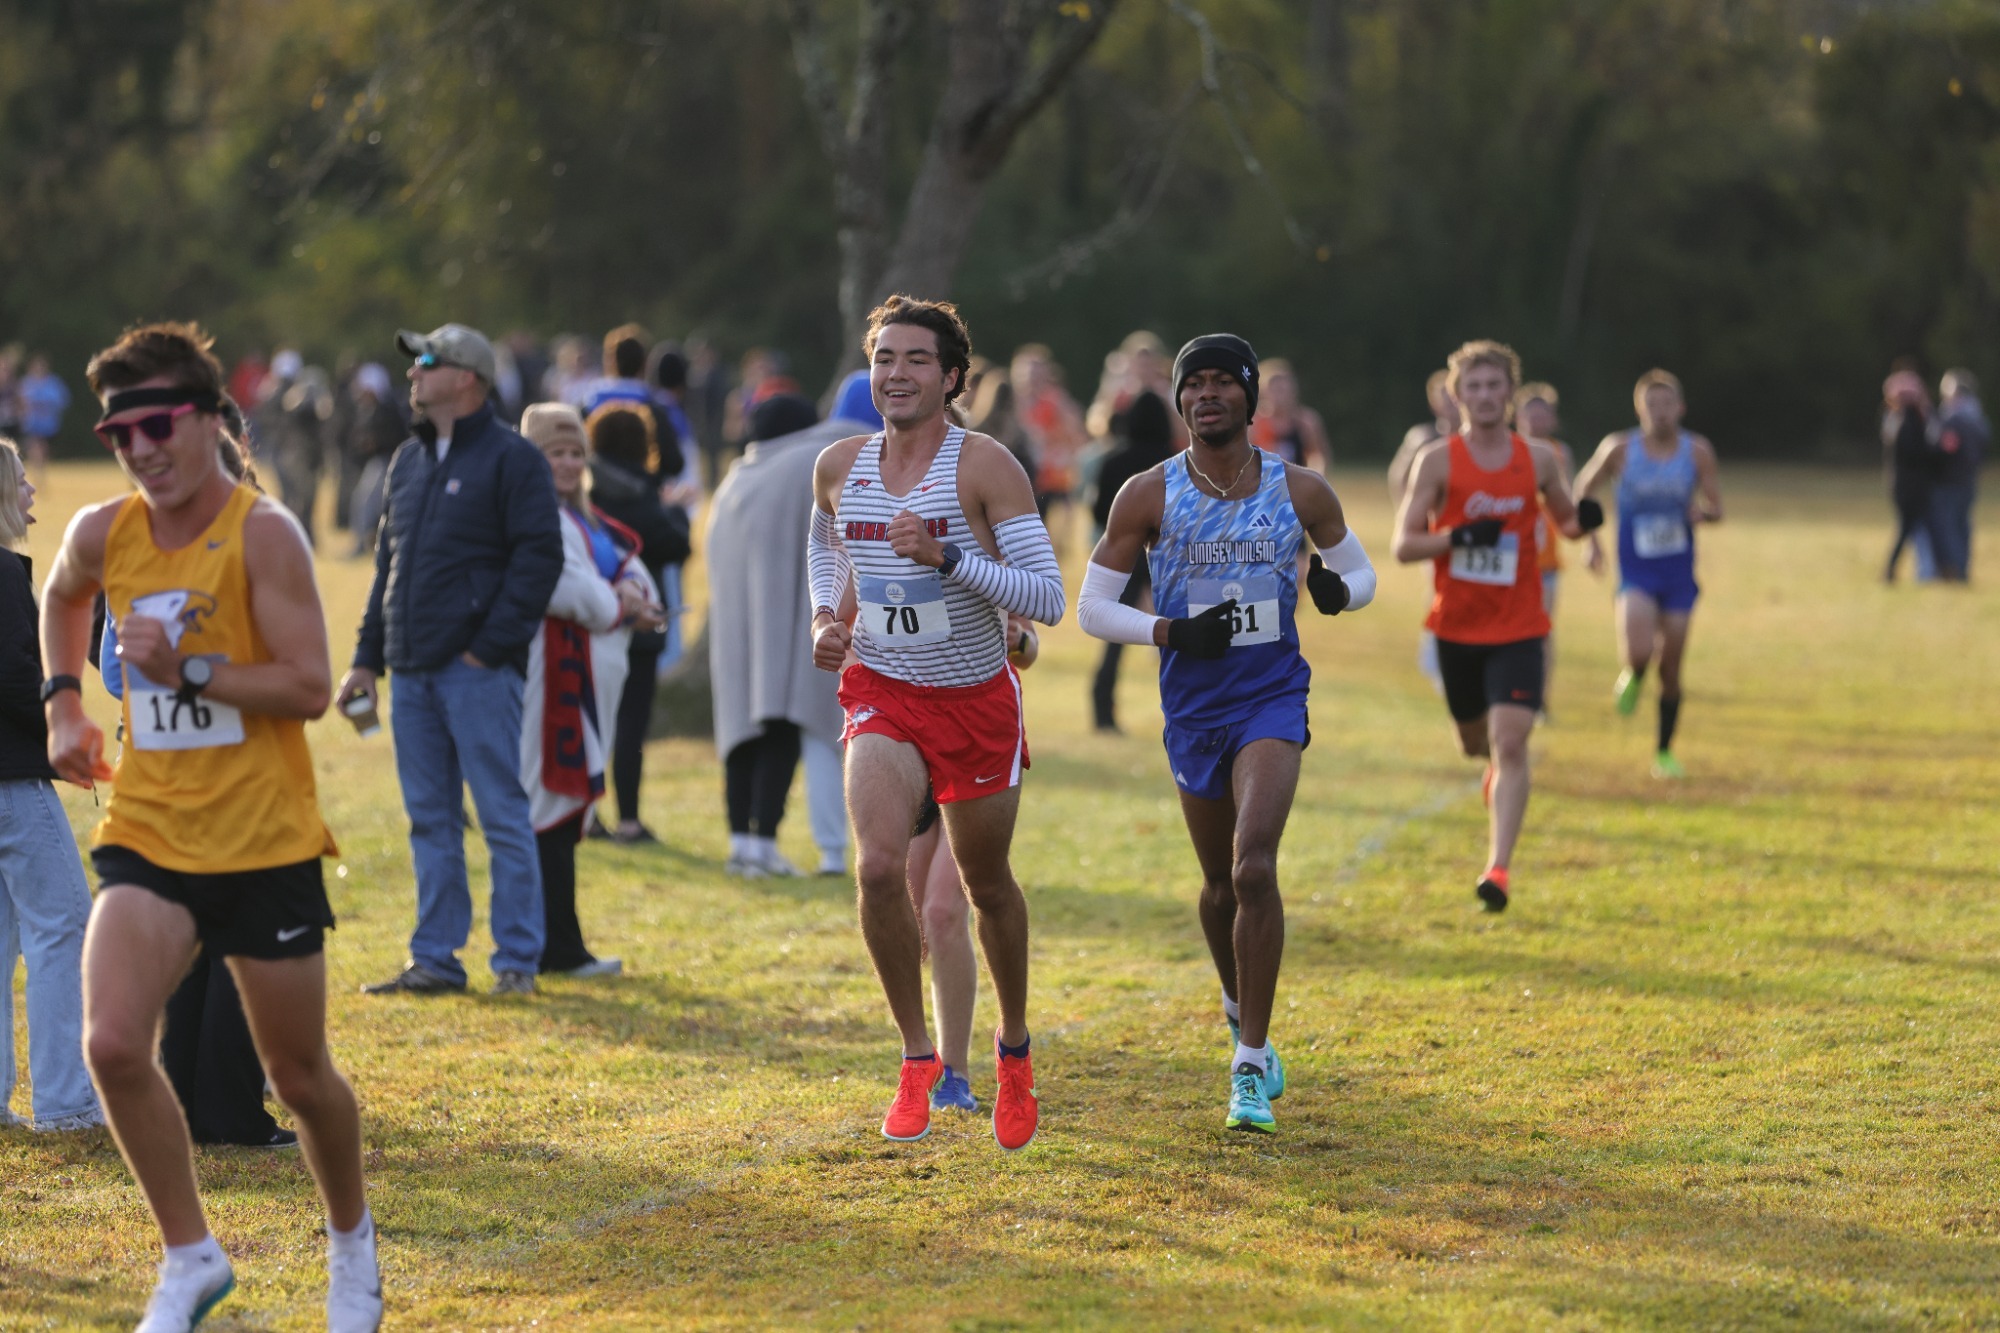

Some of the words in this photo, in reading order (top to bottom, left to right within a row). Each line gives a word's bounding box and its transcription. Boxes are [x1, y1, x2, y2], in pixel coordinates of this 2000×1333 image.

[845, 518, 949, 541] CUMBDS
[1188, 541, 1232, 565] LINDSEY
[1234, 540, 1276, 563] WILSON
[882, 606, 920, 635] 70
[150, 694, 212, 733] 176
